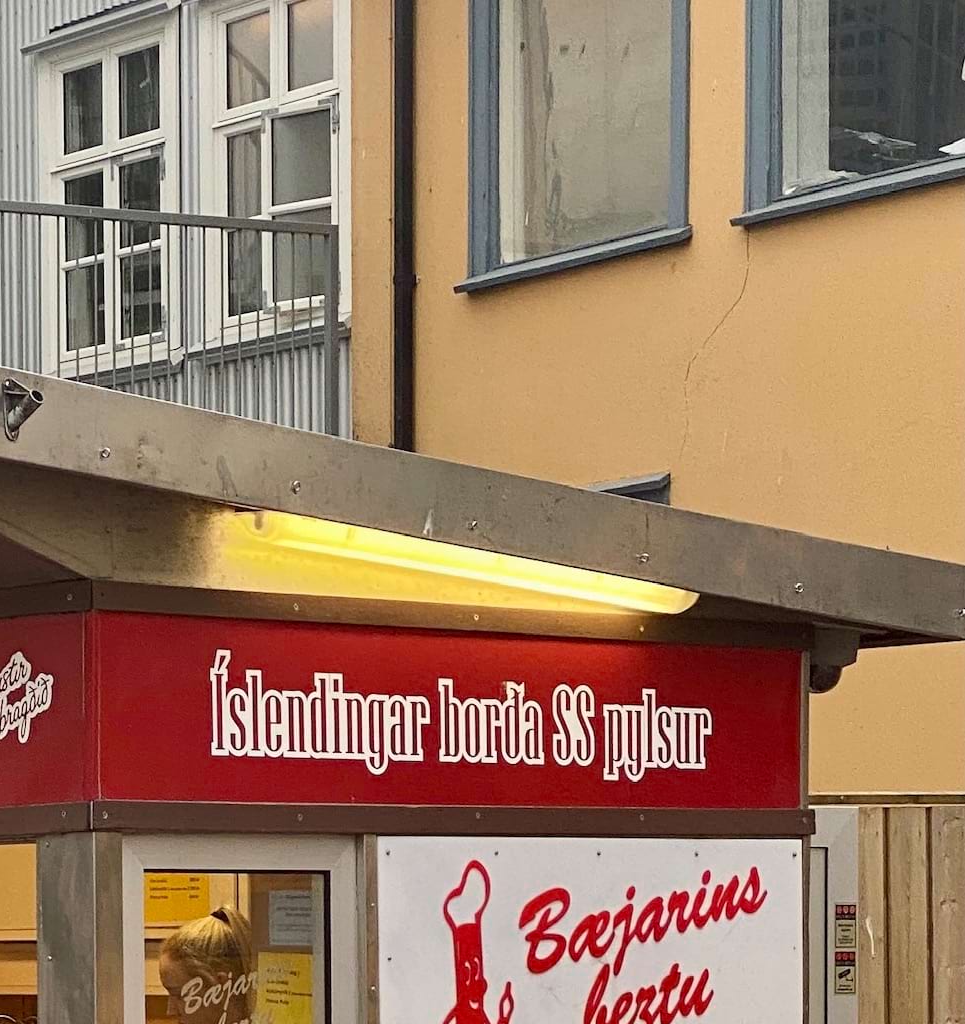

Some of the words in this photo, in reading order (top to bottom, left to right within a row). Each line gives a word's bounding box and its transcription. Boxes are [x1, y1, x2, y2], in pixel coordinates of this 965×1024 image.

[210, 649, 431, 775] Íslendingar
[438, 678, 544, 765] borða
[552, 683, 595, 767] SS
[603, 688, 713, 782] pylsur
[519, 866, 768, 976] Bæjarins
